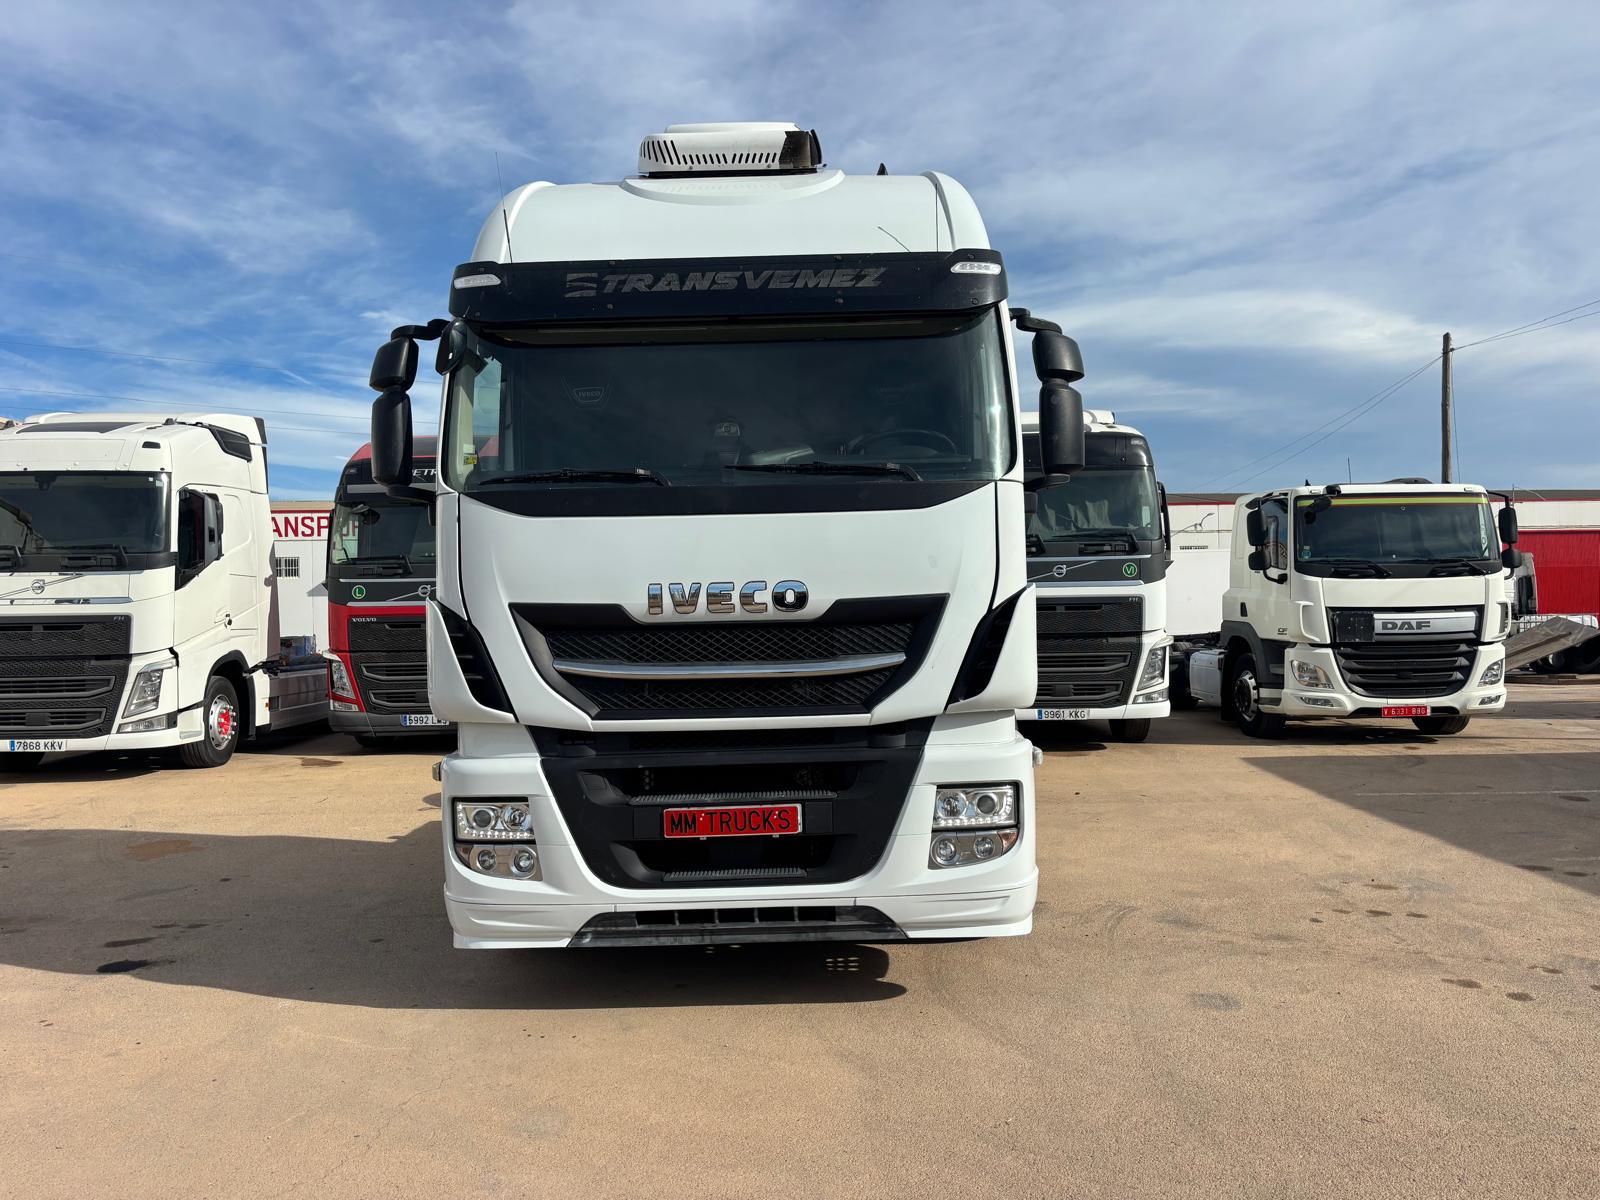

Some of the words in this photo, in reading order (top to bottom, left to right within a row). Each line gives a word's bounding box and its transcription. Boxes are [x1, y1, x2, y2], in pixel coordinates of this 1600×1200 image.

[601, 267, 887, 293] TRANSVEMEZ
[648, 580, 809, 615] IVECO
[1381, 620, 1431, 631] DAF
[408, 715, 429, 724] 5992
[1044, 710, 1065, 719] 9961
[1069, 710, 1086, 719] KKG
[16, 741, 41, 751] 7868
[43, 741, 63, 751] KKV
[670, 812, 697, 834] MM
[706, 809, 791, 833] TRUCKS
